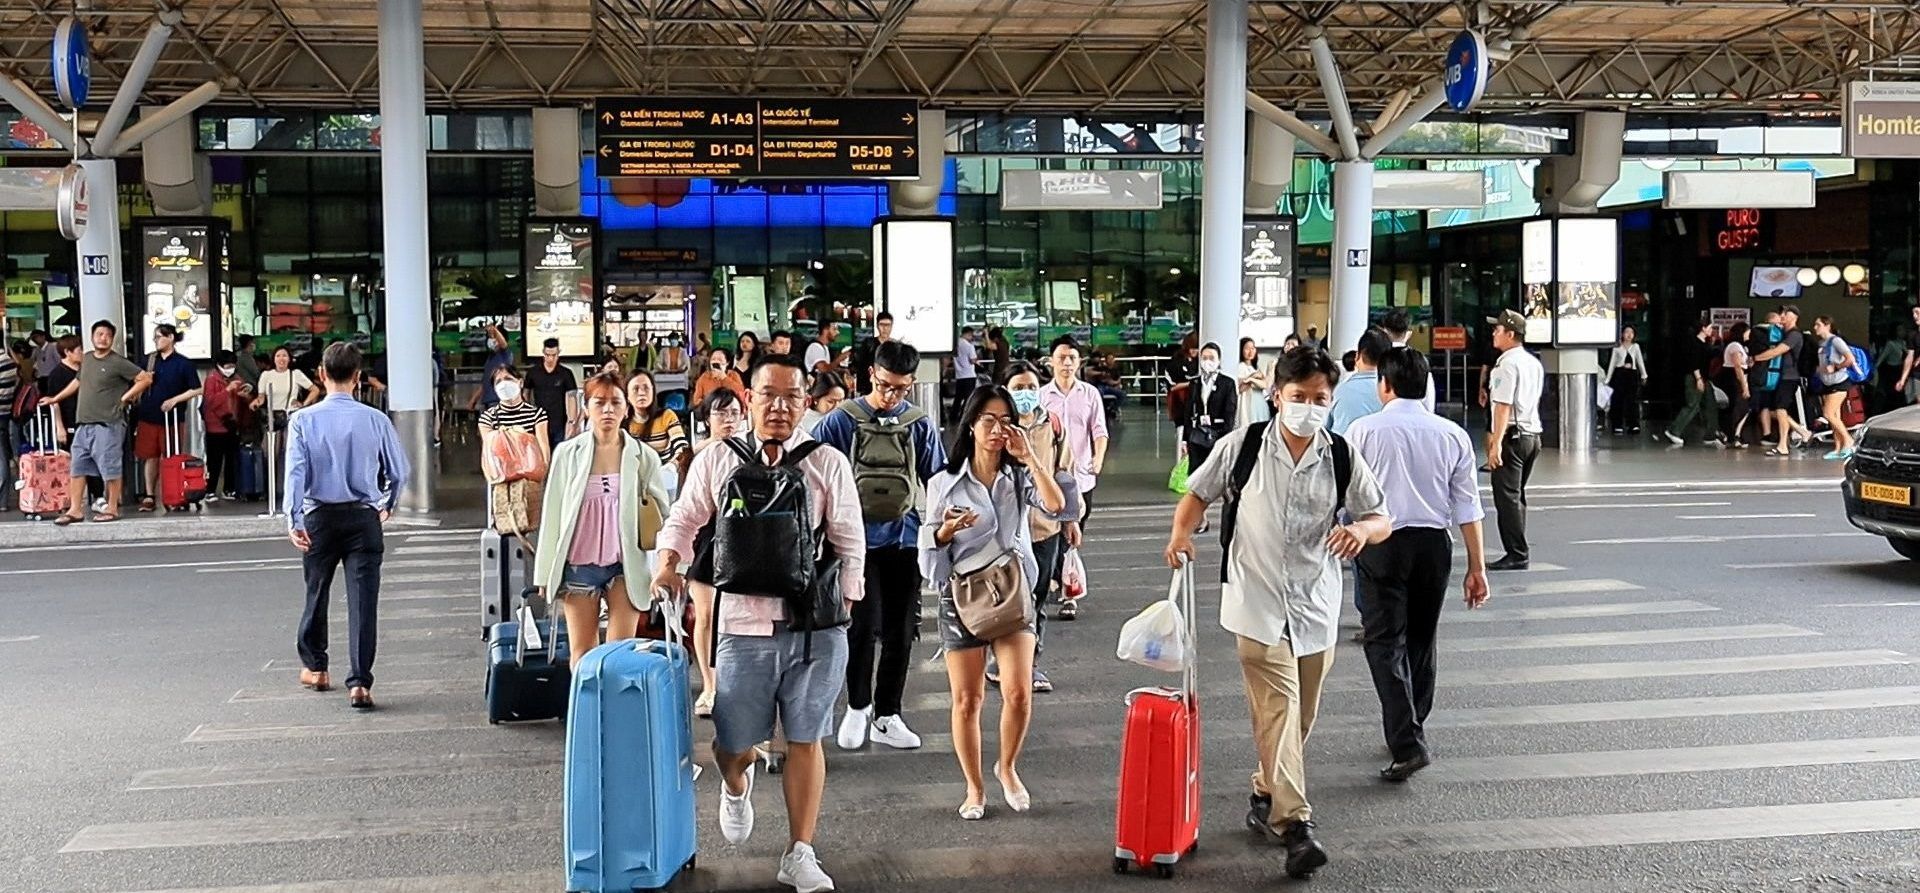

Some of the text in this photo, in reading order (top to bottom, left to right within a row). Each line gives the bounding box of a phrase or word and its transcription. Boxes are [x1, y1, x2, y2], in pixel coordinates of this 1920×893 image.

[653, 110, 680, 118] TRONG
[711, 113, 754, 125] A1-A3
[711, 144, 754, 156] D1-D4
[850, 146, 892, 157] D5-D8
[1728, 208, 1759, 226] PURO
[84, 257, 108, 274] A-09
